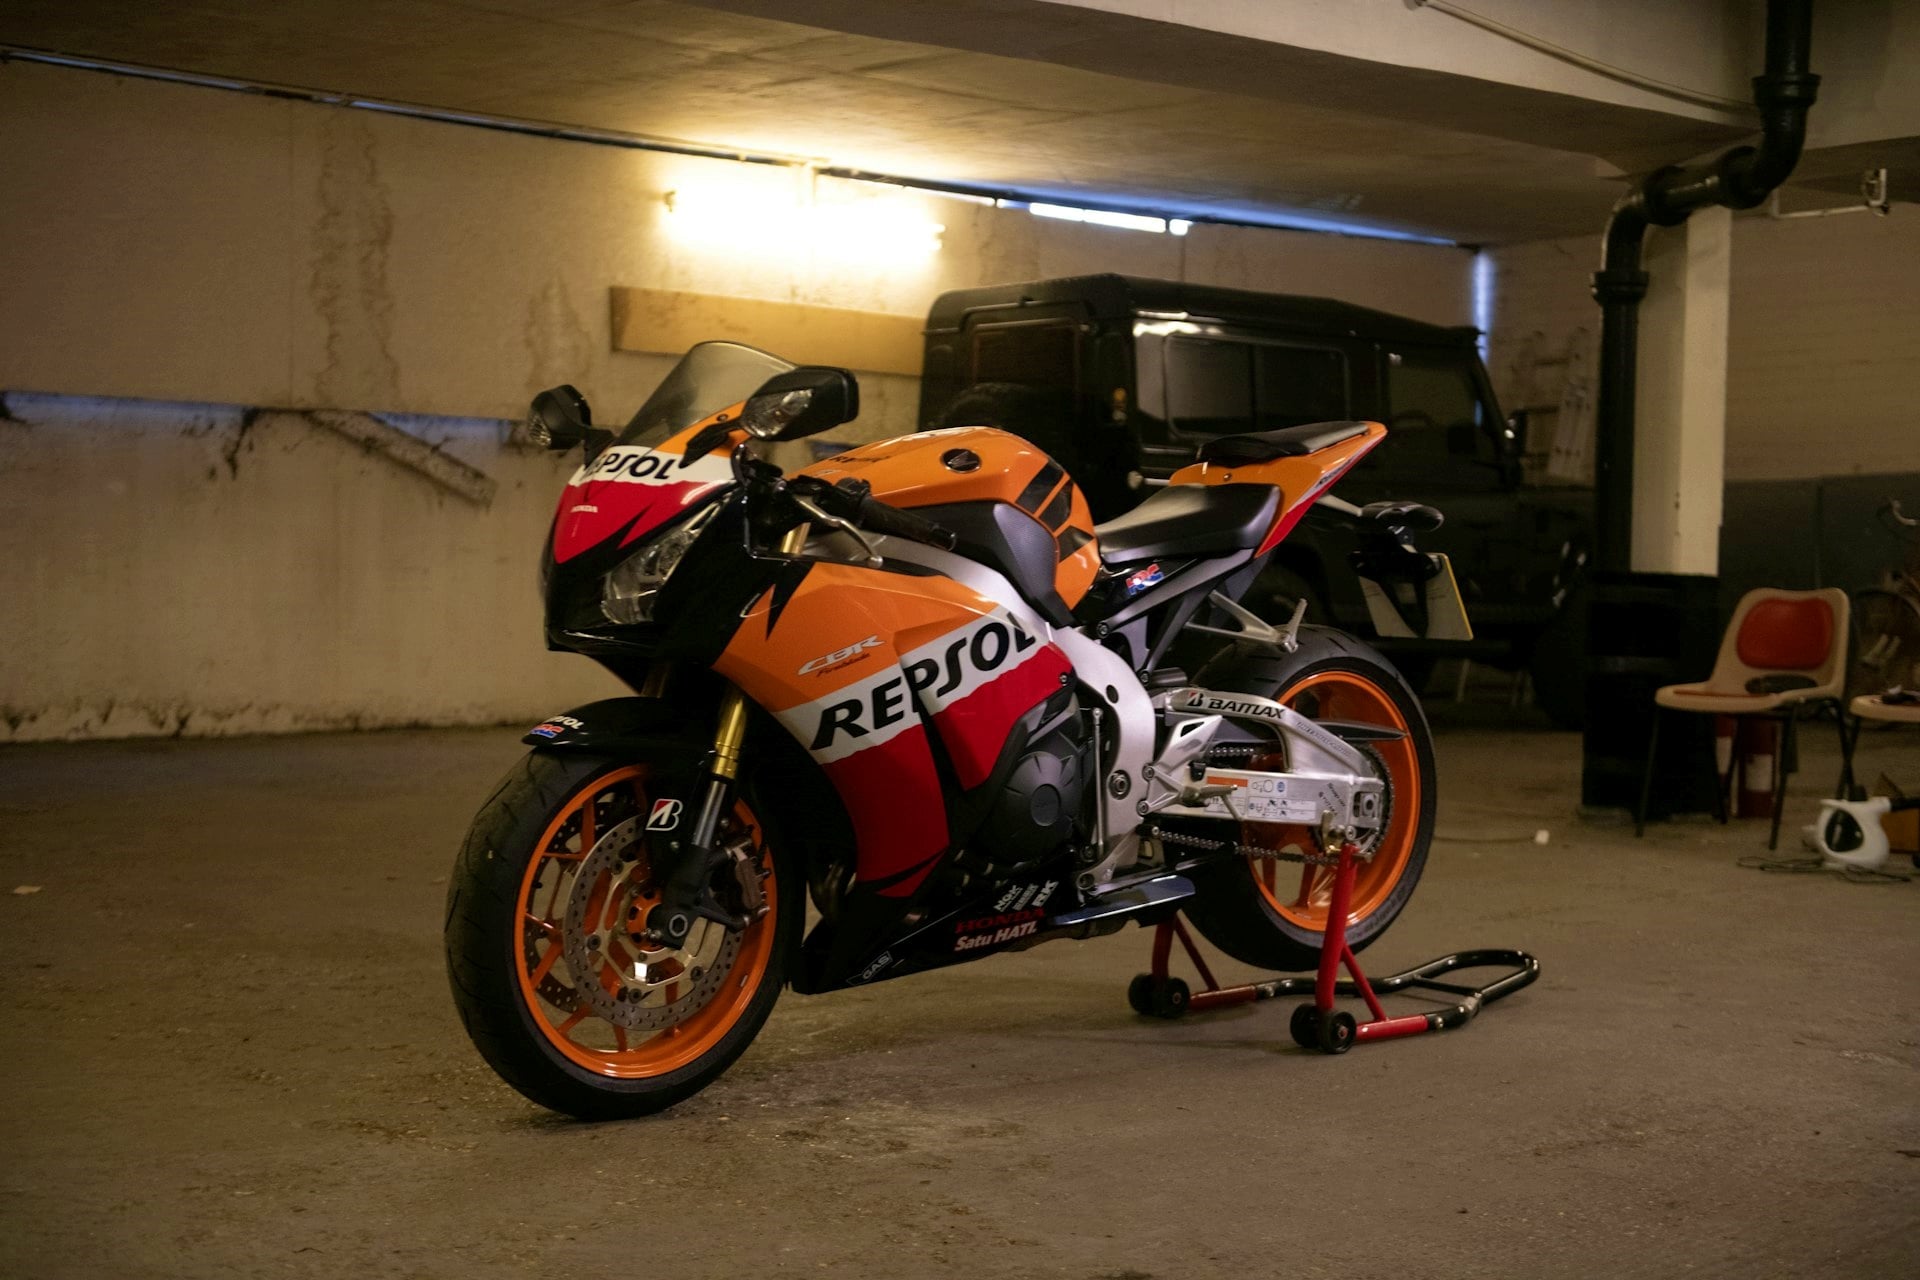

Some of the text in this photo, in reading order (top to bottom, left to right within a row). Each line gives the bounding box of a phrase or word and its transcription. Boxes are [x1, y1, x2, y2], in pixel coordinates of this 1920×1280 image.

[798, 635, 886, 676] CBR
[809, 611, 1036, 751] REPSOL
[1208, 698, 1285, 719] BATTLAX
[954, 907, 1045, 934] HONDA
[954, 935, 994, 952] Satu
